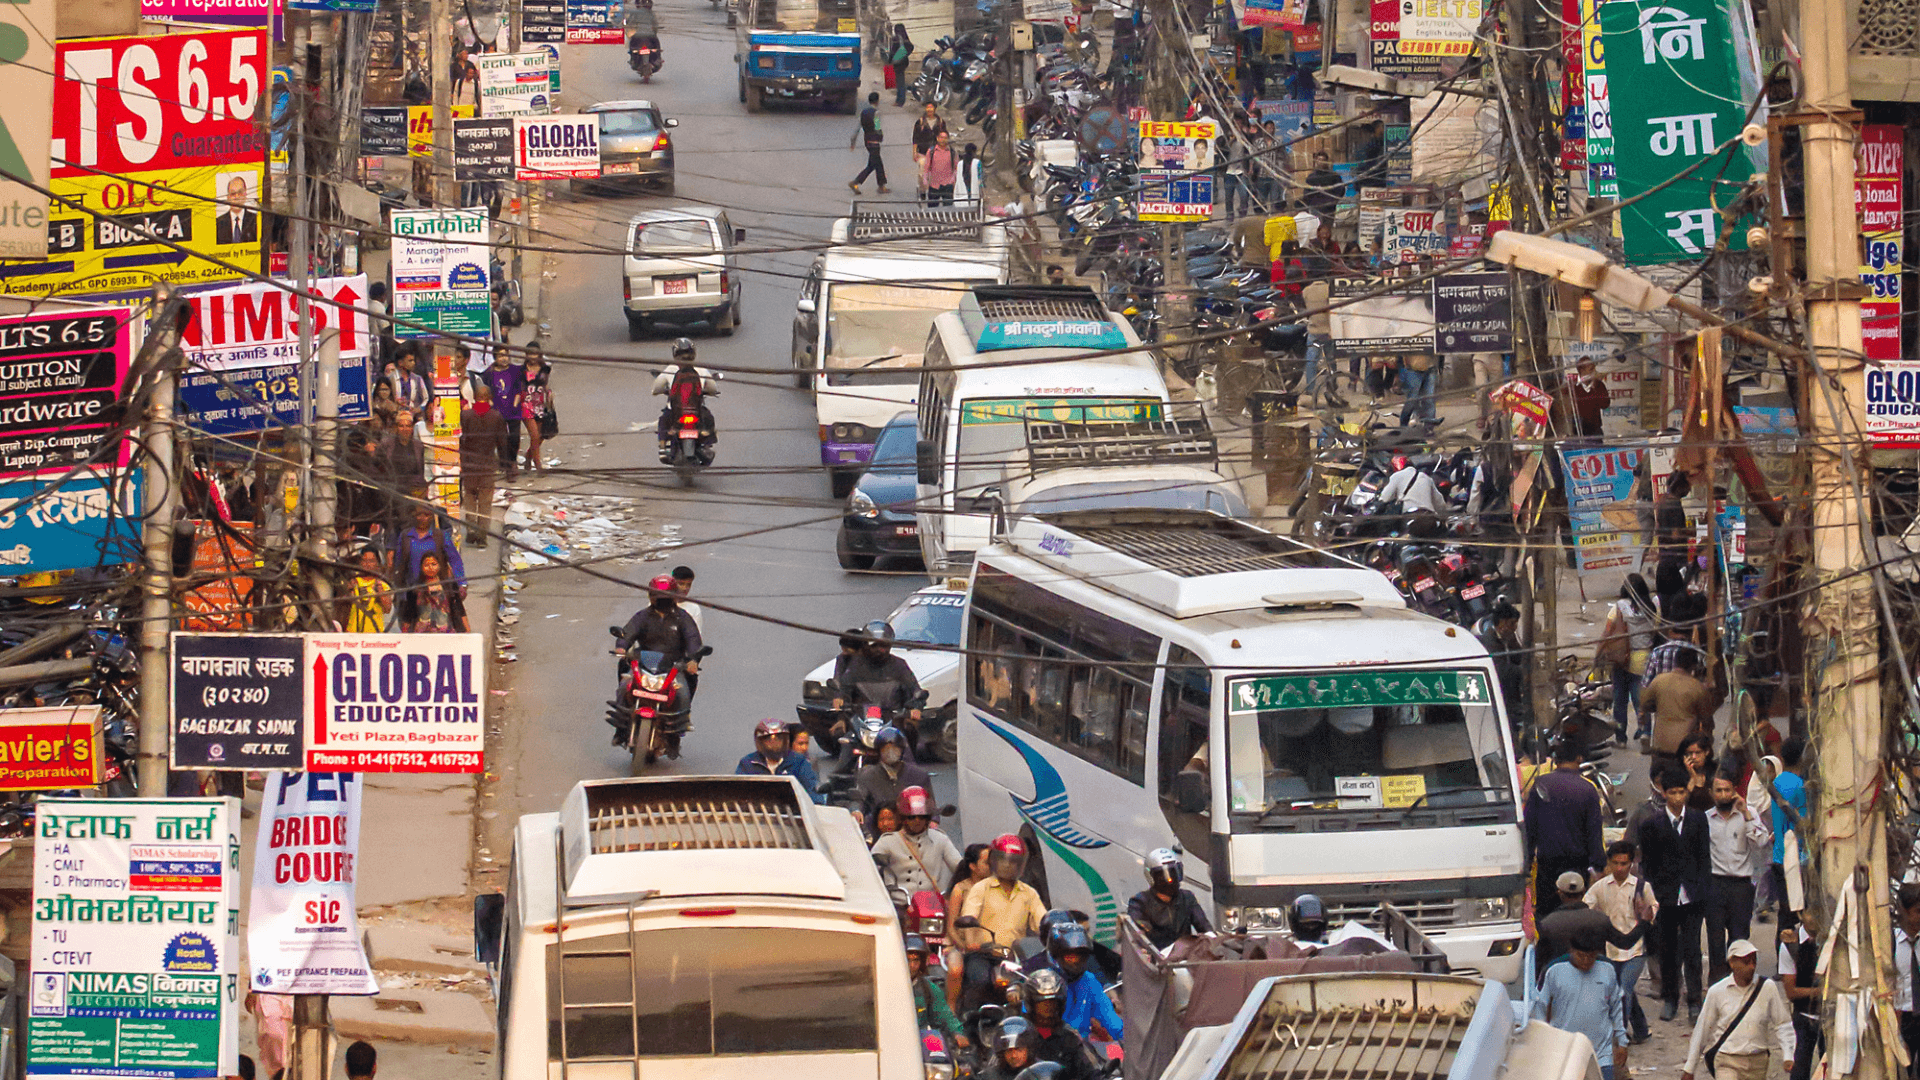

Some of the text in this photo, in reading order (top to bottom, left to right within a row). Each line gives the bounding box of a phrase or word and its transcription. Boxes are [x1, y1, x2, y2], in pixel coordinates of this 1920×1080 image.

[1416, 0, 1481, 19] IELTS
[568, 12, 605, 23] Latvia
[567, 29, 600, 39] raffles
[1416, 29, 1442, 37] English
[1639, 7, 1707, 64] नि
[1401, 41, 1441, 53] STUDY
[178, 36, 259, 124] 6.5
[528, 124, 597, 149] GLOBAL
[1142, 122, 1213, 137] IELTS
[1647, 113, 1718, 156] मा
[529, 148, 598, 158] EDUCATION
[102, 180, 168, 210] OLC
[1138, 203, 1213, 215] PACIFIC INT'L
[1665, 208, 1716, 254] स
[406, 247, 469, 257] Management
[420, 256, 444, 264] Level
[4, 282, 55, 296] Academy
[88, 279, 108, 288] GPO
[110, 276, 138, 287] 69936
[413, 292, 454, 301] NIMAS
[61, 321, 105, 343] 6.5
[228, 346, 267, 362] अगाडि
[8, 378, 41, 391] subject
[55, 373, 86, 386] faculty
[4, 454, 44, 469] Laptop
[255, 657, 295, 678] सडक
[332, 652, 478, 703] GLOBAL
[202, 686, 270, 707] (३०२४०)
[1255, 675, 1465, 706] MAHAKAL
[334, 705, 478, 723] EDUCATION
[179, 718, 297, 735] BAGBAZAR SADAK
[330, 731, 360, 743] Yeti
[313, 754, 348, 765] Phone
[358, 754, 427, 767] 01-4167512,
[429, 754, 479, 767] 4167524
[0, 767, 90, 779] Preparation
[42, 807, 218, 840] स्टाफ नर्स
[54, 843, 71, 855] HA
[132, 848, 166, 858] NIMAS
[54, 859, 85, 871] CMLT
[53, 875, 65, 887] D.
[68, 875, 128, 891] Pharmacy
[305, 900, 340, 924] SLC
[52, 930, 67, 943] TU
[179, 937, 203, 946] Own
[52, 951, 93, 965] CTEVT
[176, 949, 206, 959] Hostel
[167, 960, 213, 971] Available
[67, 974, 148, 993] NIMAS
[152, 973, 219, 994] निमास
[67, 995, 146, 1007] EDUCATION
[68, 1007, 167, 1019] Nurturing Your
